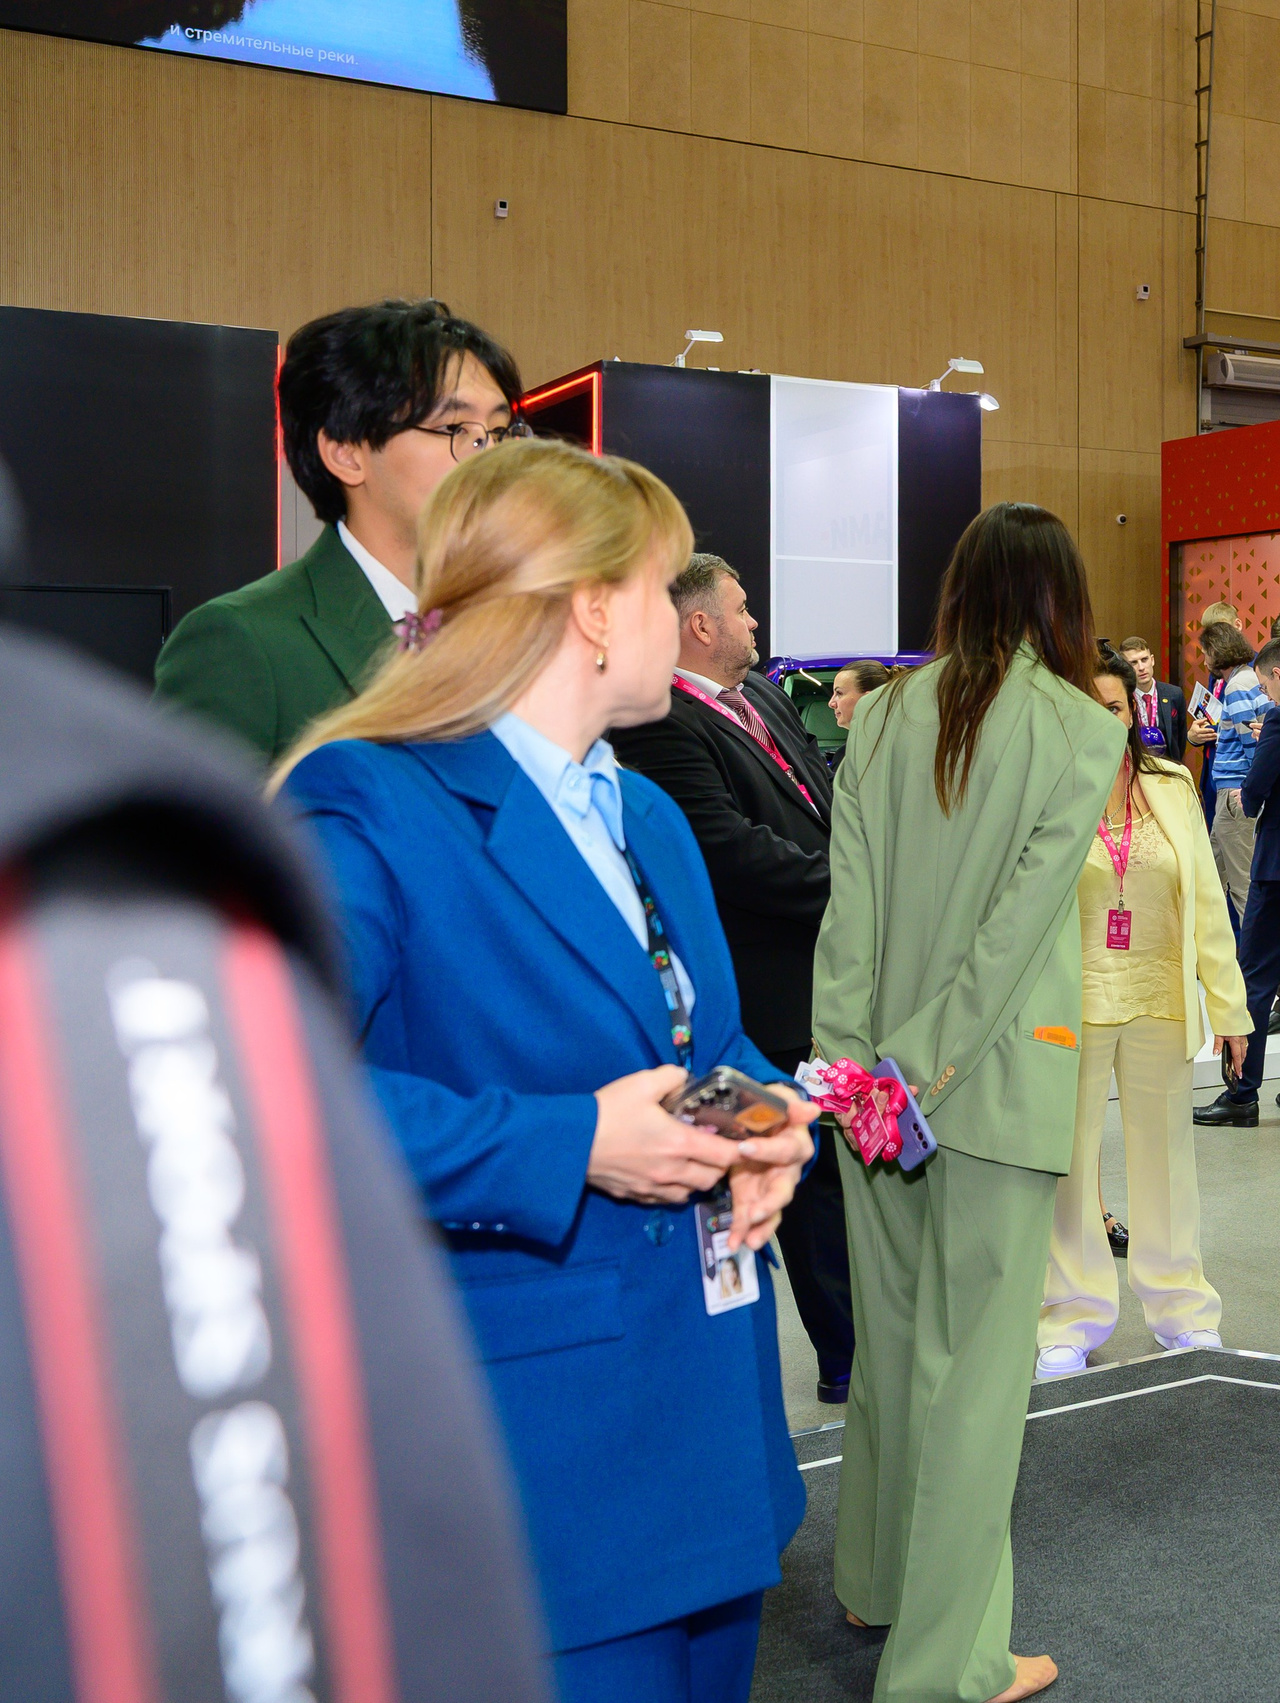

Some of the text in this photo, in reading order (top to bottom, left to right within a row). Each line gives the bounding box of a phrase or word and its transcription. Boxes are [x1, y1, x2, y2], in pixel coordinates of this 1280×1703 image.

[170, 24, 359, 65] и стремительные реки.
